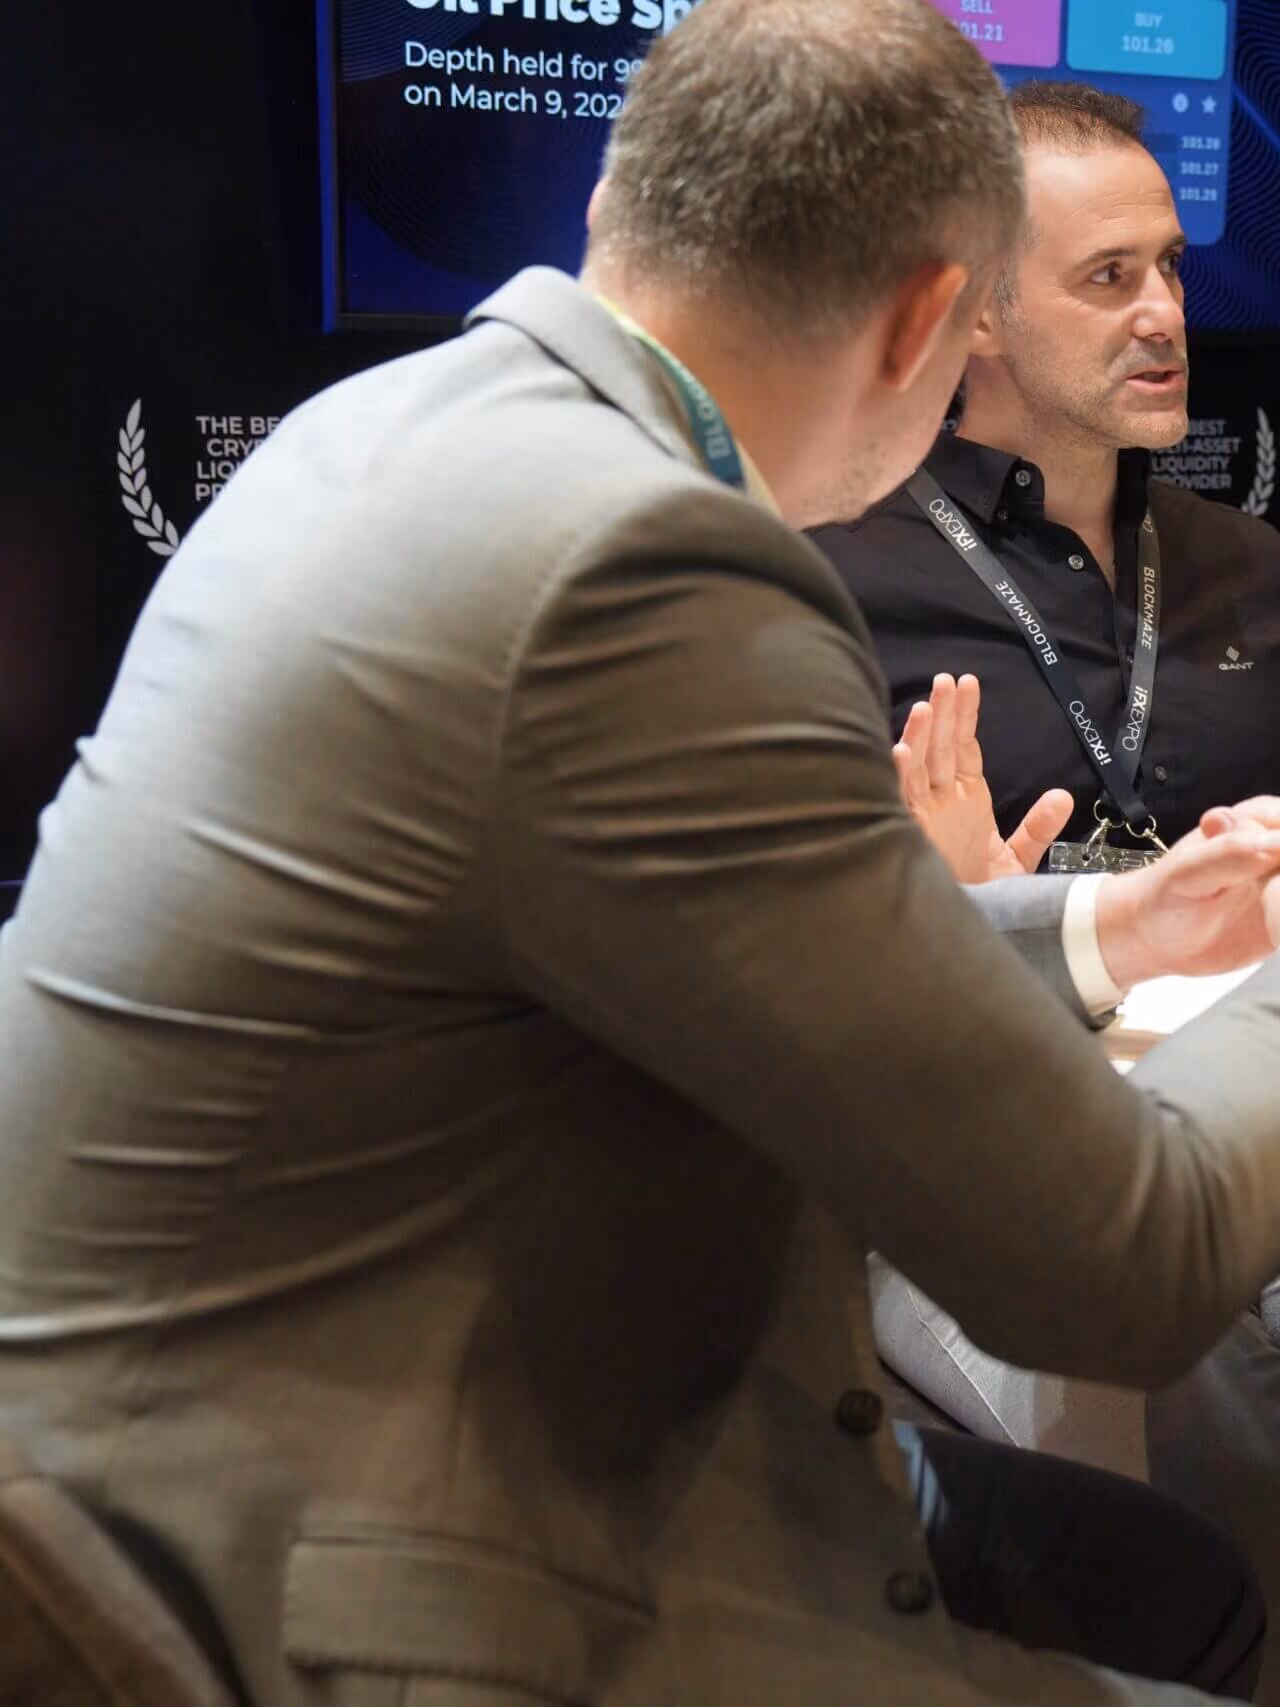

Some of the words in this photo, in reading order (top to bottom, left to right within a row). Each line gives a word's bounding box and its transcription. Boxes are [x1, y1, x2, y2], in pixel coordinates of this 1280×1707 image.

[1134, 12, 1163, 28] BUY
[405, 40, 494, 75] Depth
[503, 47, 563, 78] held
[571, 53, 608, 81] for
[404, 84, 441, 107] on
[451, 83, 537, 113] March
[545, 90, 567, 118] 9,
[574, 94, 621, 118] 202
[195, 416, 243, 435] THE
[196, 461, 240, 480] LIQ
[995, 580, 1058, 665] BLOCKMAZE
[1141, 566, 1155, 649] BLOCKMAZE
